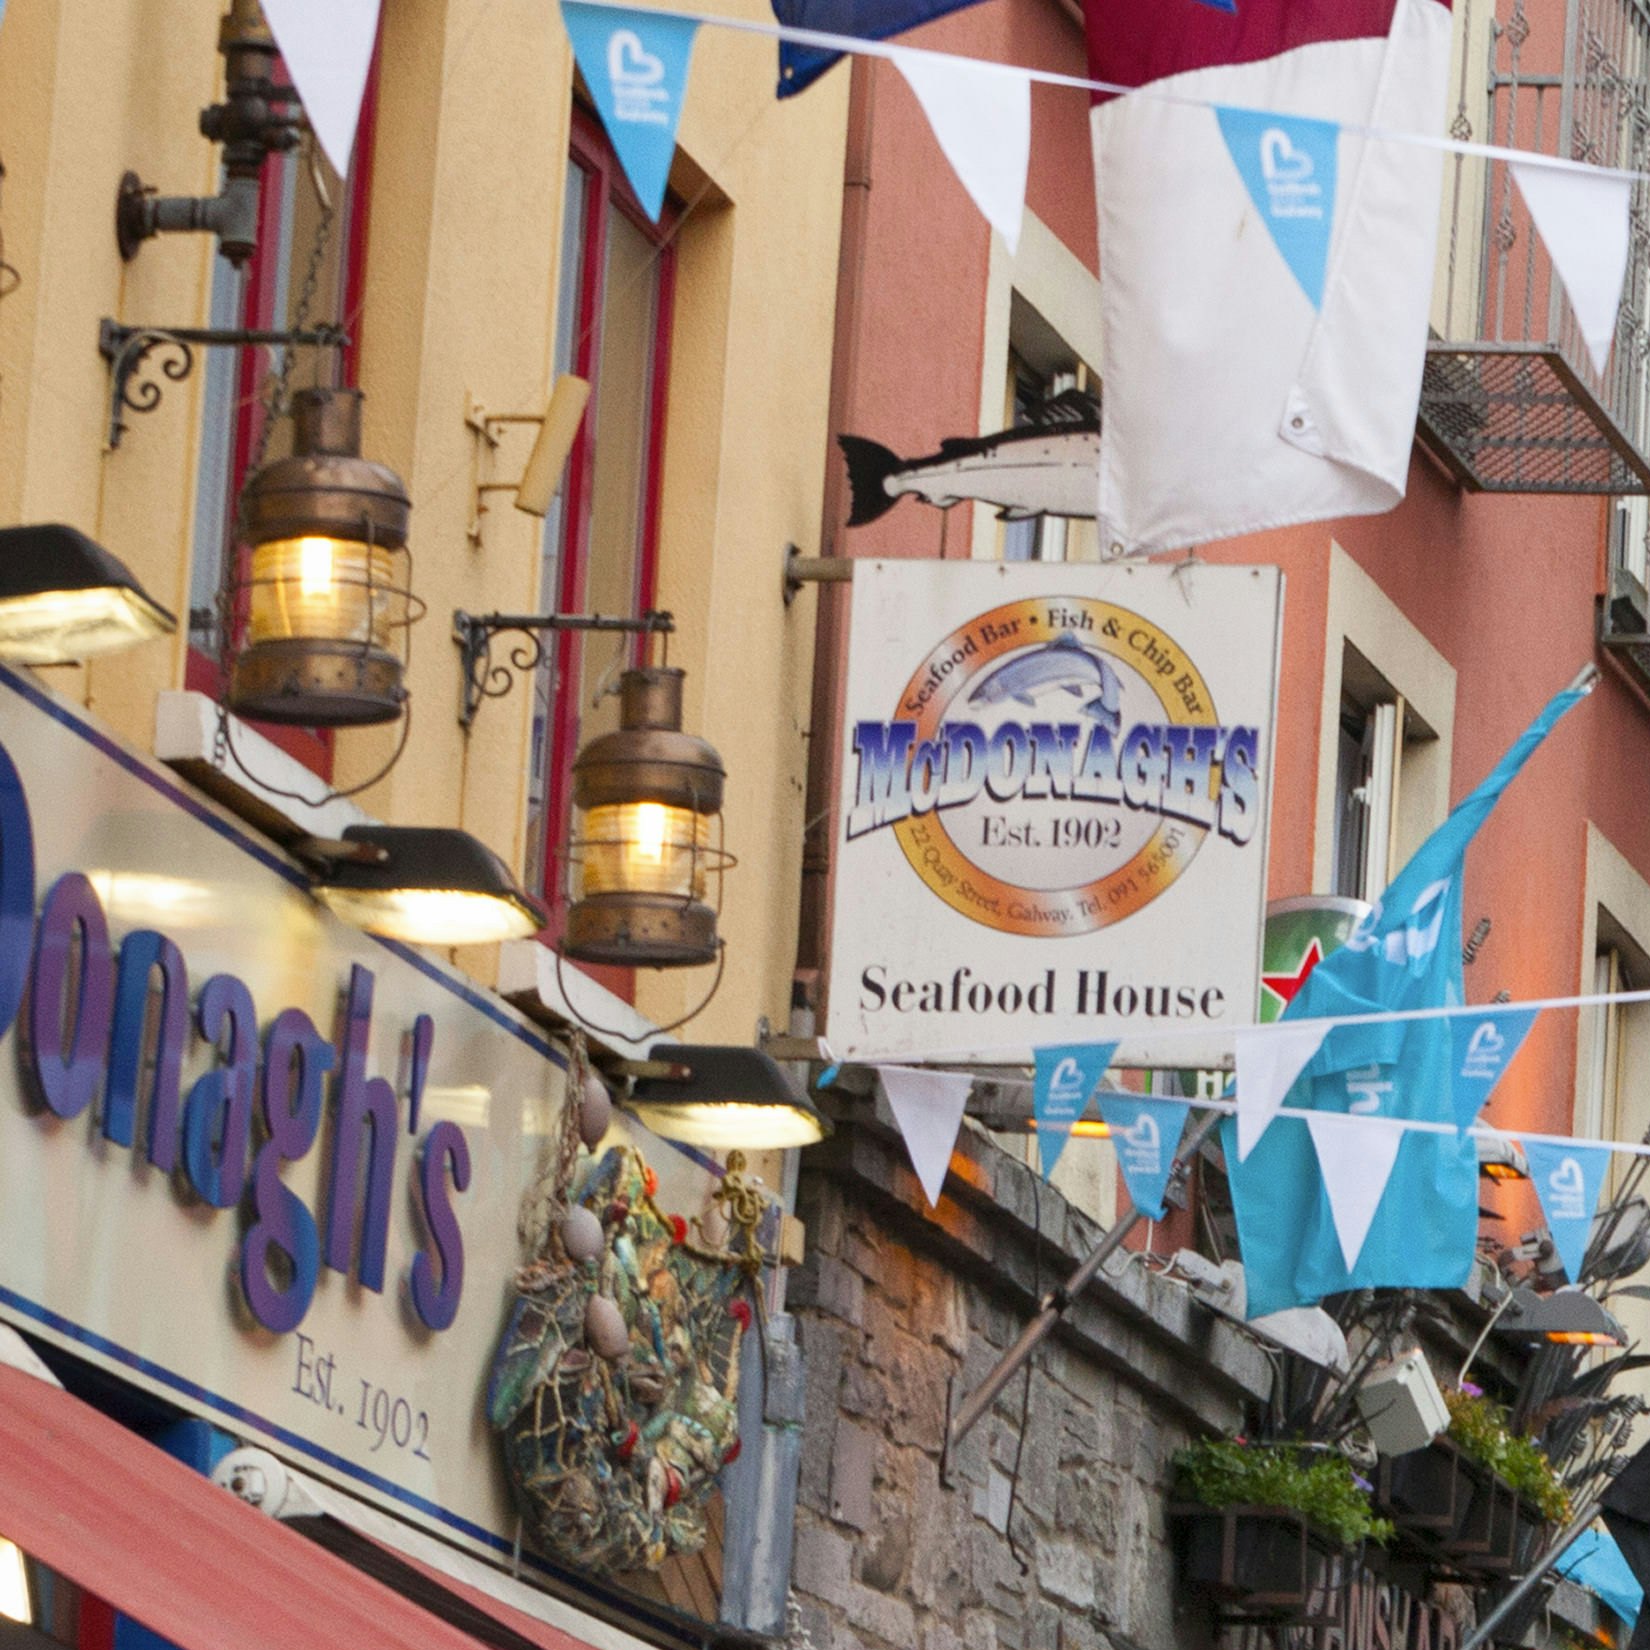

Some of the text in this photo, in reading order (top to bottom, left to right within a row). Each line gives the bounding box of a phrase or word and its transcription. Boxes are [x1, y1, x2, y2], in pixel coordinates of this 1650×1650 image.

[905, 608, 1204, 716] Seafood Bar Fish & Chip Bar
[847, 720, 1260, 848] McDONAGH'S
[980, 815, 1122, 849] Est. 1902
[910, 823, 931, 849] 22
[924, 849, 958, 887] Quay
[1107, 878, 1139, 904] 091
[0, 738, 471, 1334] onagh's
[859, 964, 1226, 1018] Seafood House
[292, 1333, 433, 1461] Est. 1902
